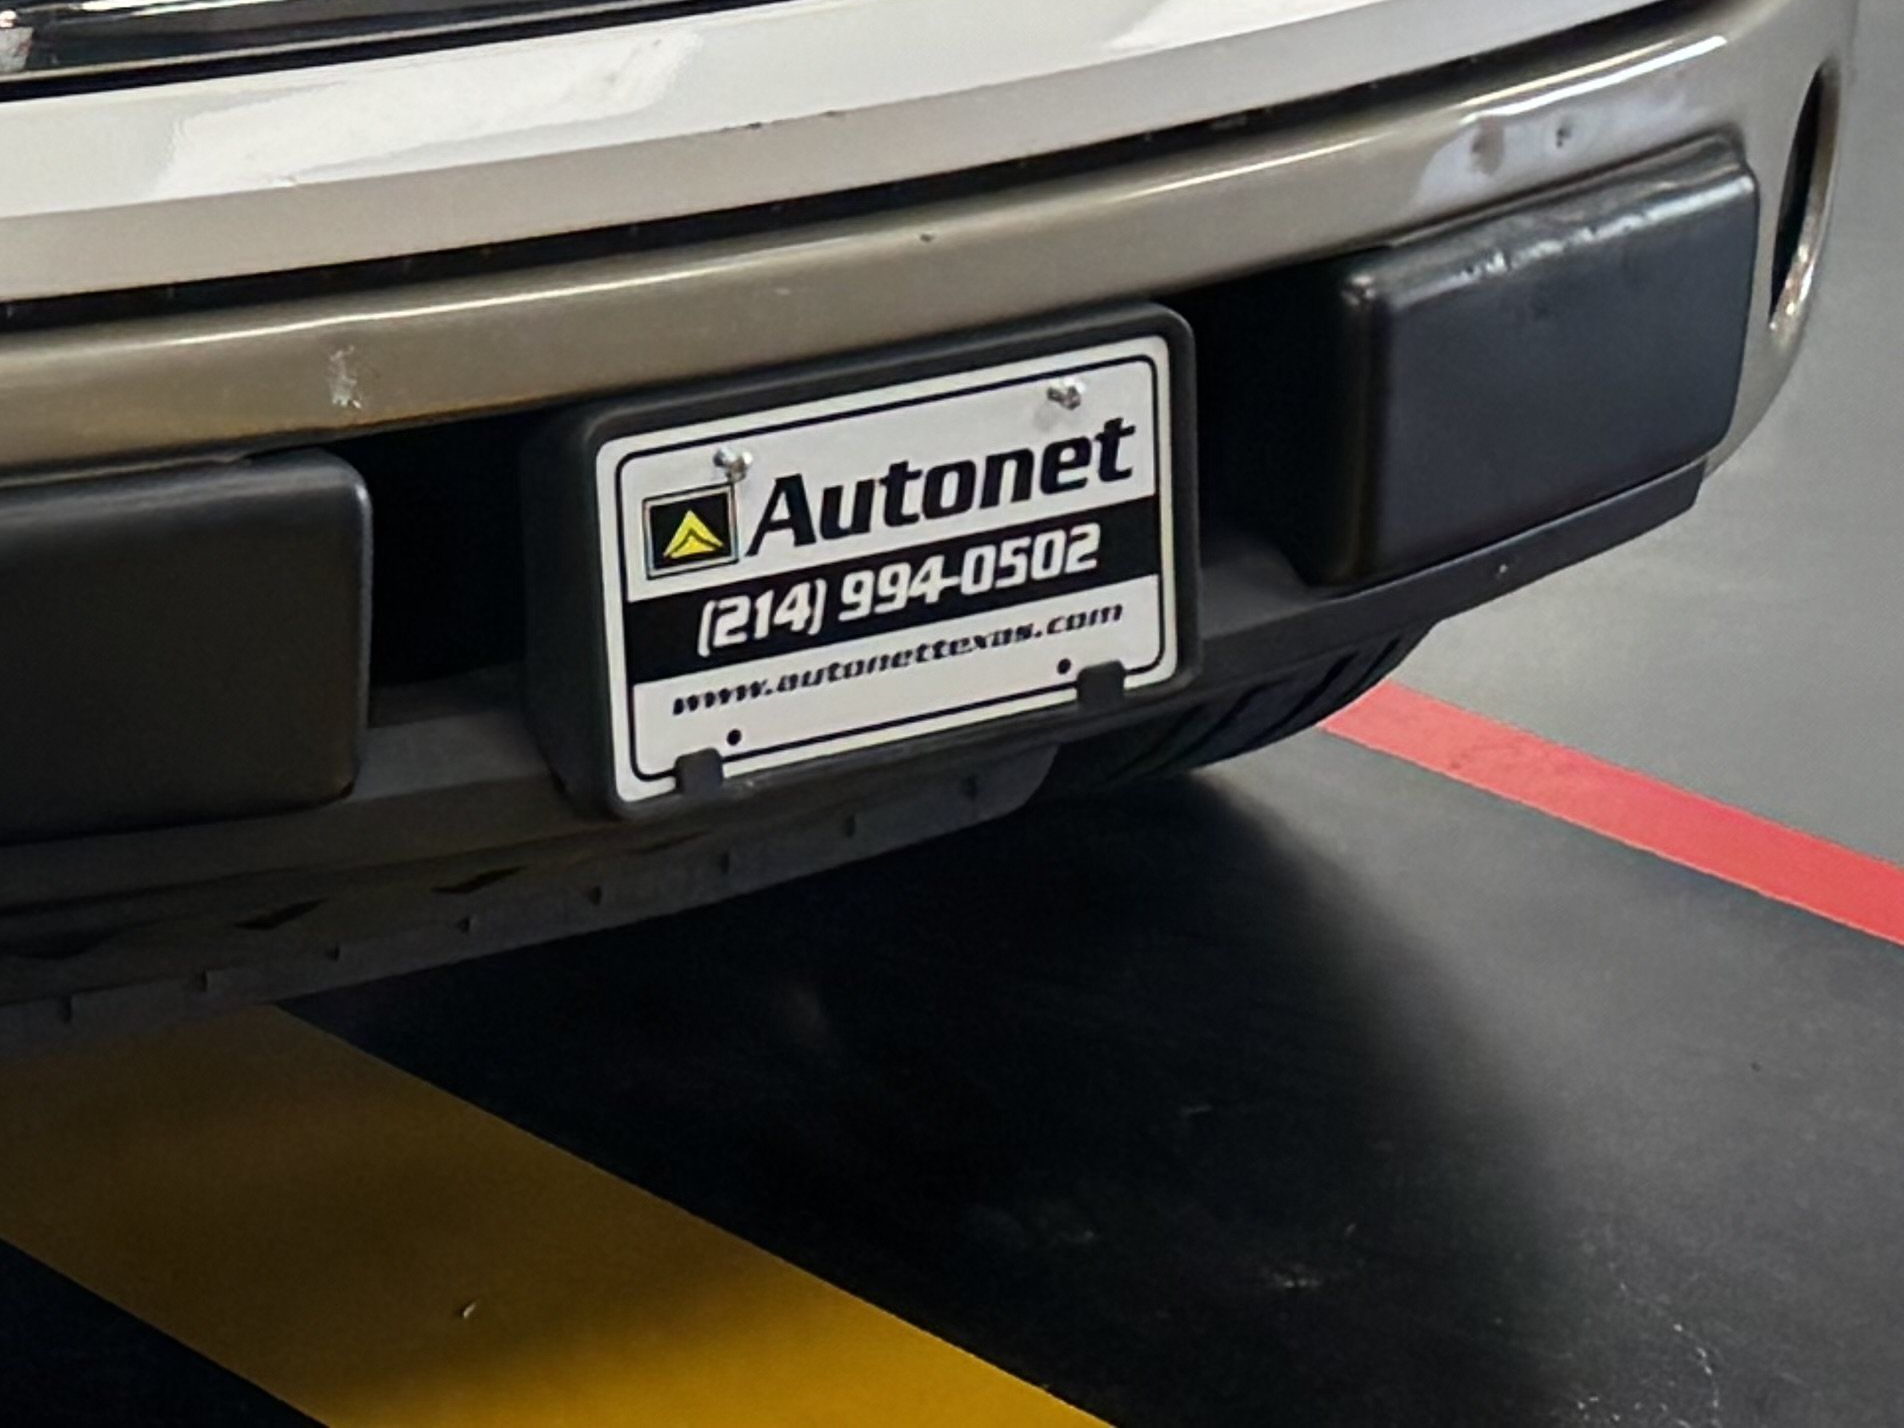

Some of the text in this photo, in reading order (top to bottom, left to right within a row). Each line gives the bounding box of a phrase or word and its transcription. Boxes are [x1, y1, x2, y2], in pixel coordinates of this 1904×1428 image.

[745, 416, 1137, 558] Autonet
[697, 522, 1101, 658] (214) 994-0502
[671, 602, 1123, 716] www.autonettexas.com
